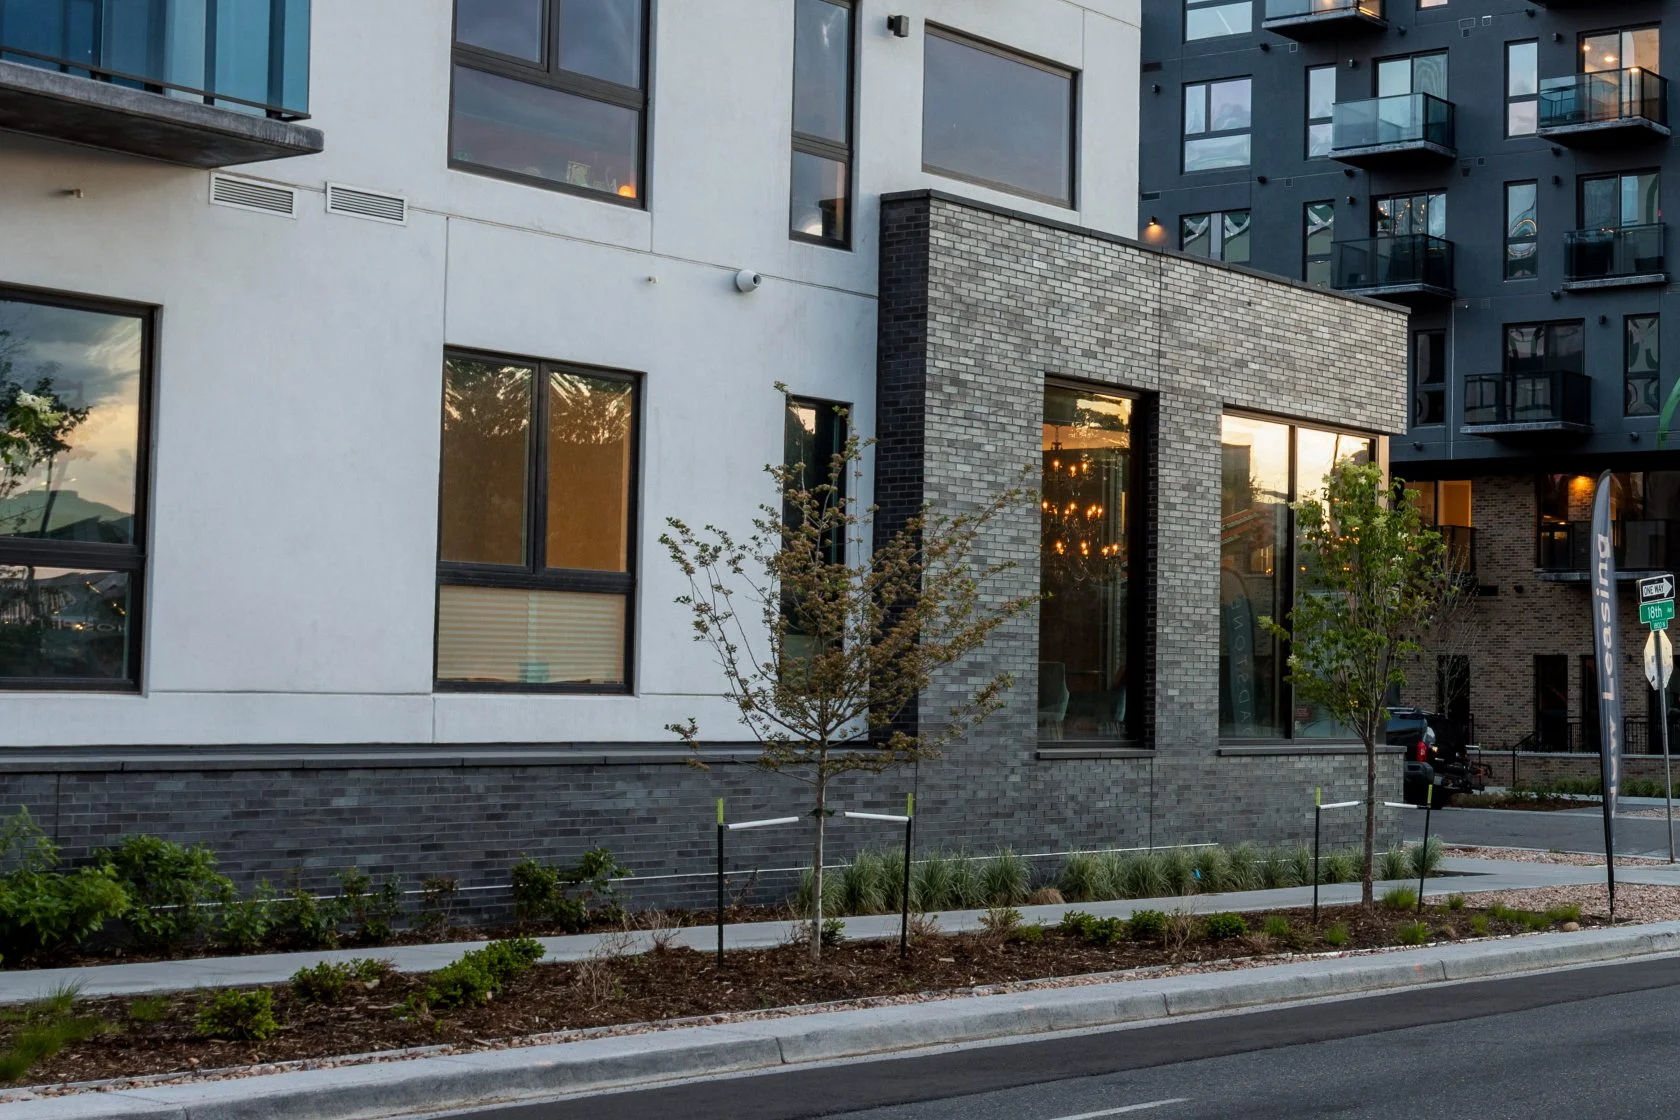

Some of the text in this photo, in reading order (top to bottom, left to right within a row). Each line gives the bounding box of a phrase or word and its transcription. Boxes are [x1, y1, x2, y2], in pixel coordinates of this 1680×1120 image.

[1643, 584, 1664, 595] ONE WAY
[1596, 533, 1615, 701] Leasing
[1647, 605, 1663, 619] 18th
